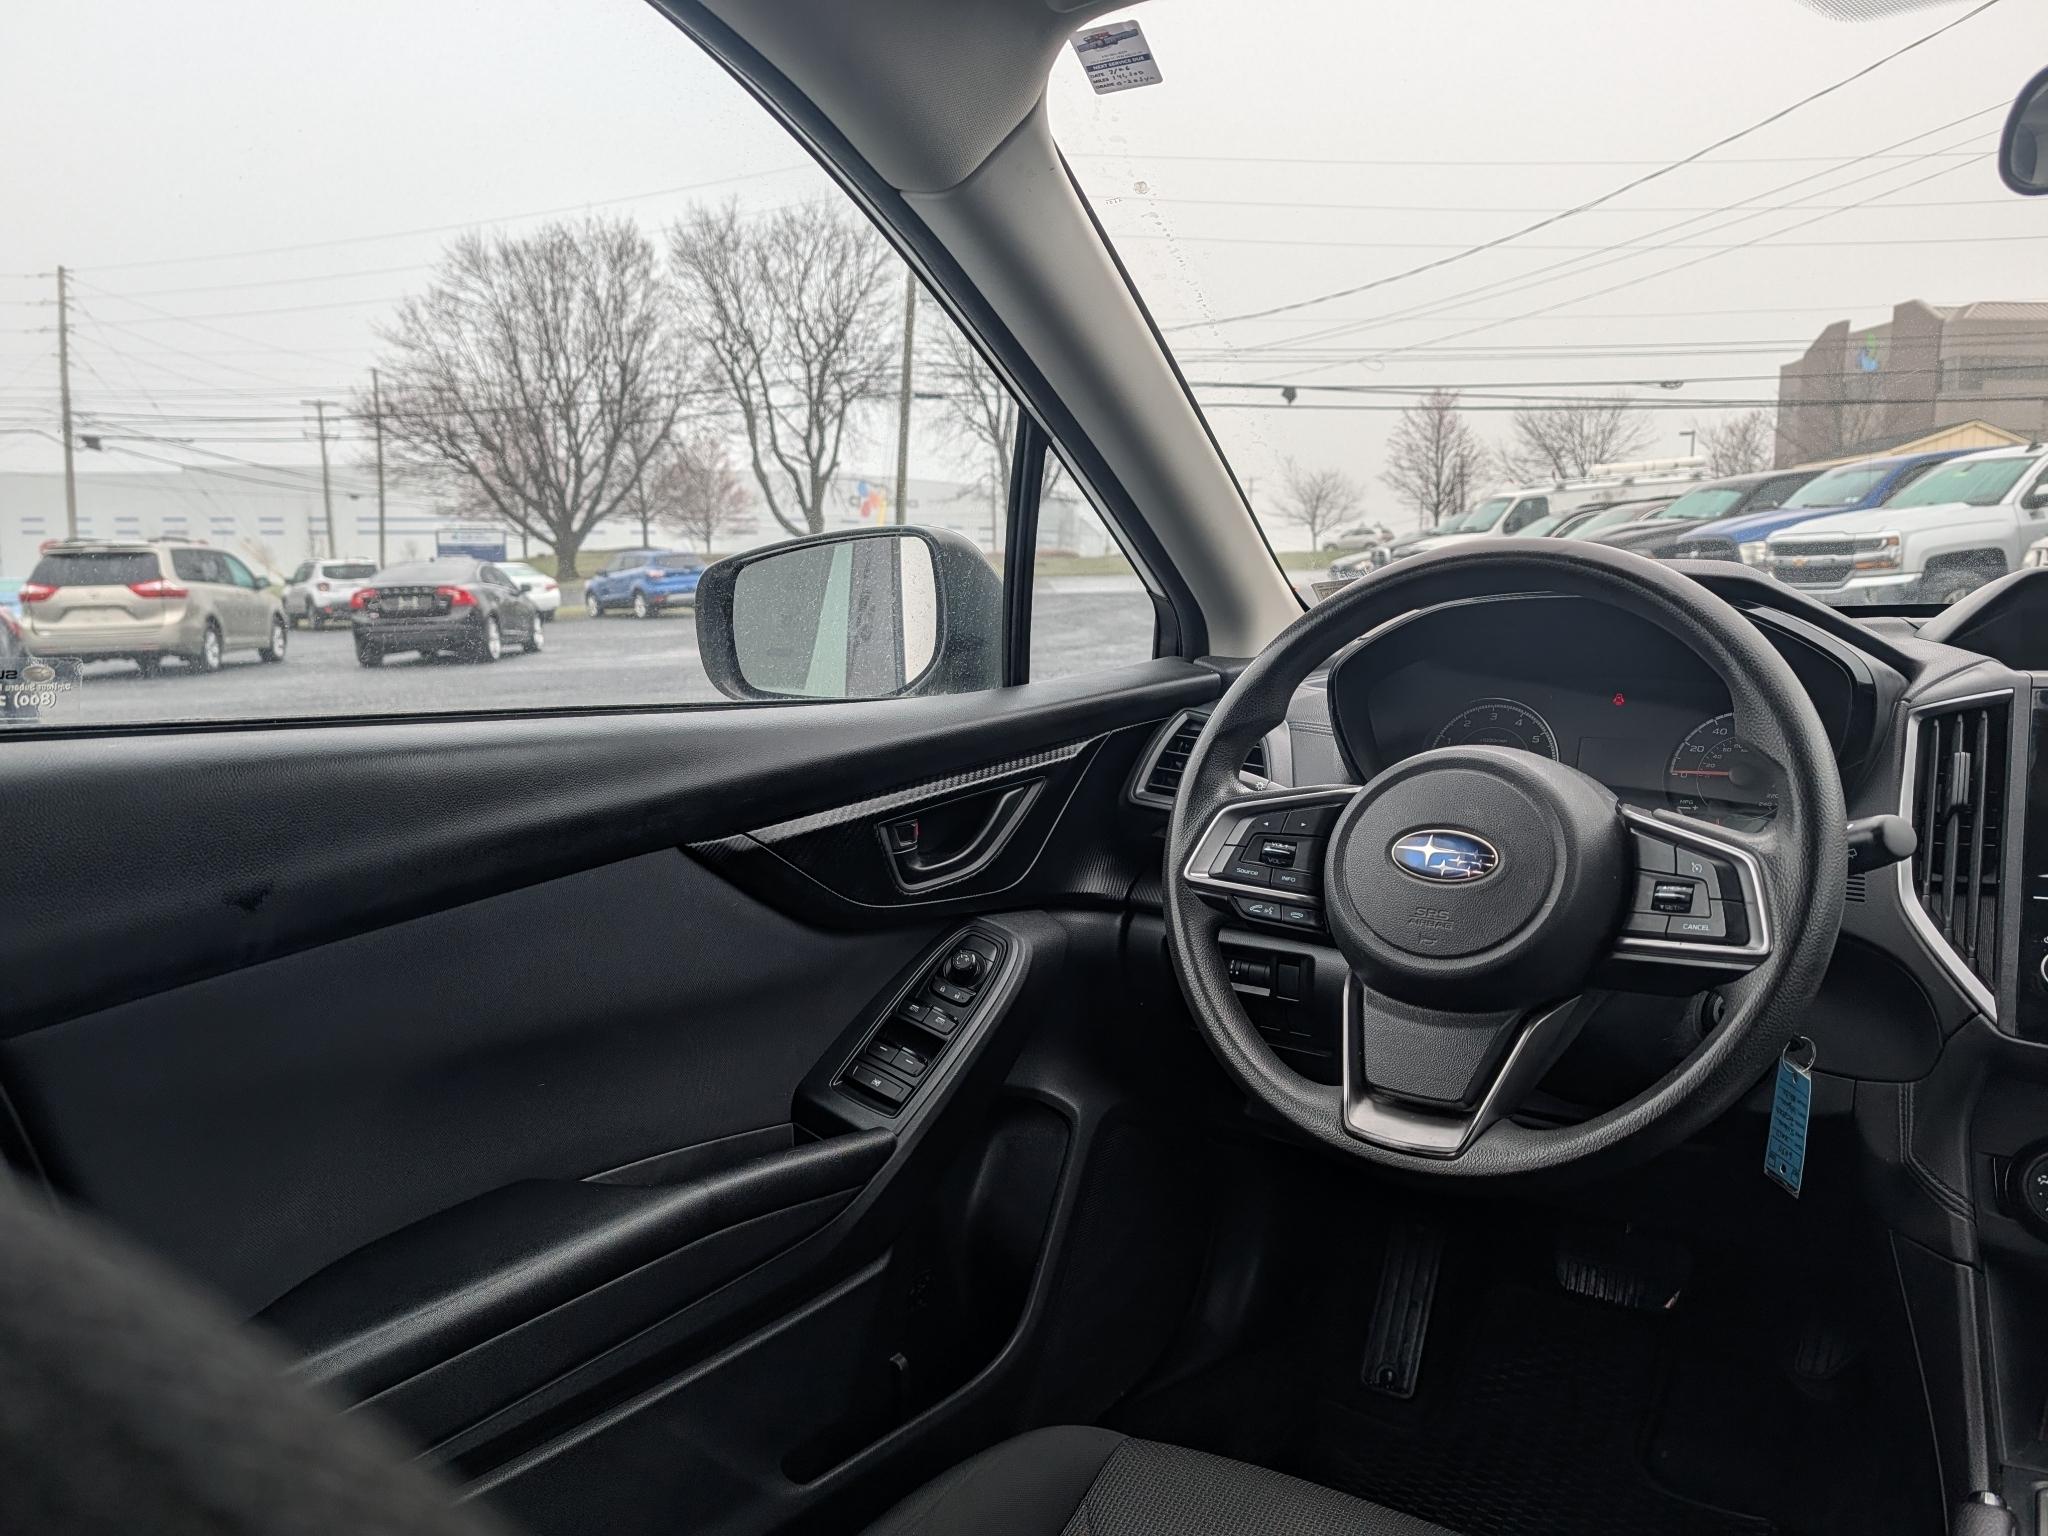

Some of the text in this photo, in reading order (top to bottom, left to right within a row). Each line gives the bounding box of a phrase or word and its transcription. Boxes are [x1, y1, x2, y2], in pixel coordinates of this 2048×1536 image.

[1109, 58, 1132, 67] SERVICE
[1489, 712, 1498, 720] 3
[1712, 728, 1728, 736] 40
[1532, 735, 1540, 743] 5
[1689, 745, 1705, 753] 20
[1236, 867, 1259, 876] Source
[1281, 875, 1296, 883] INFO
